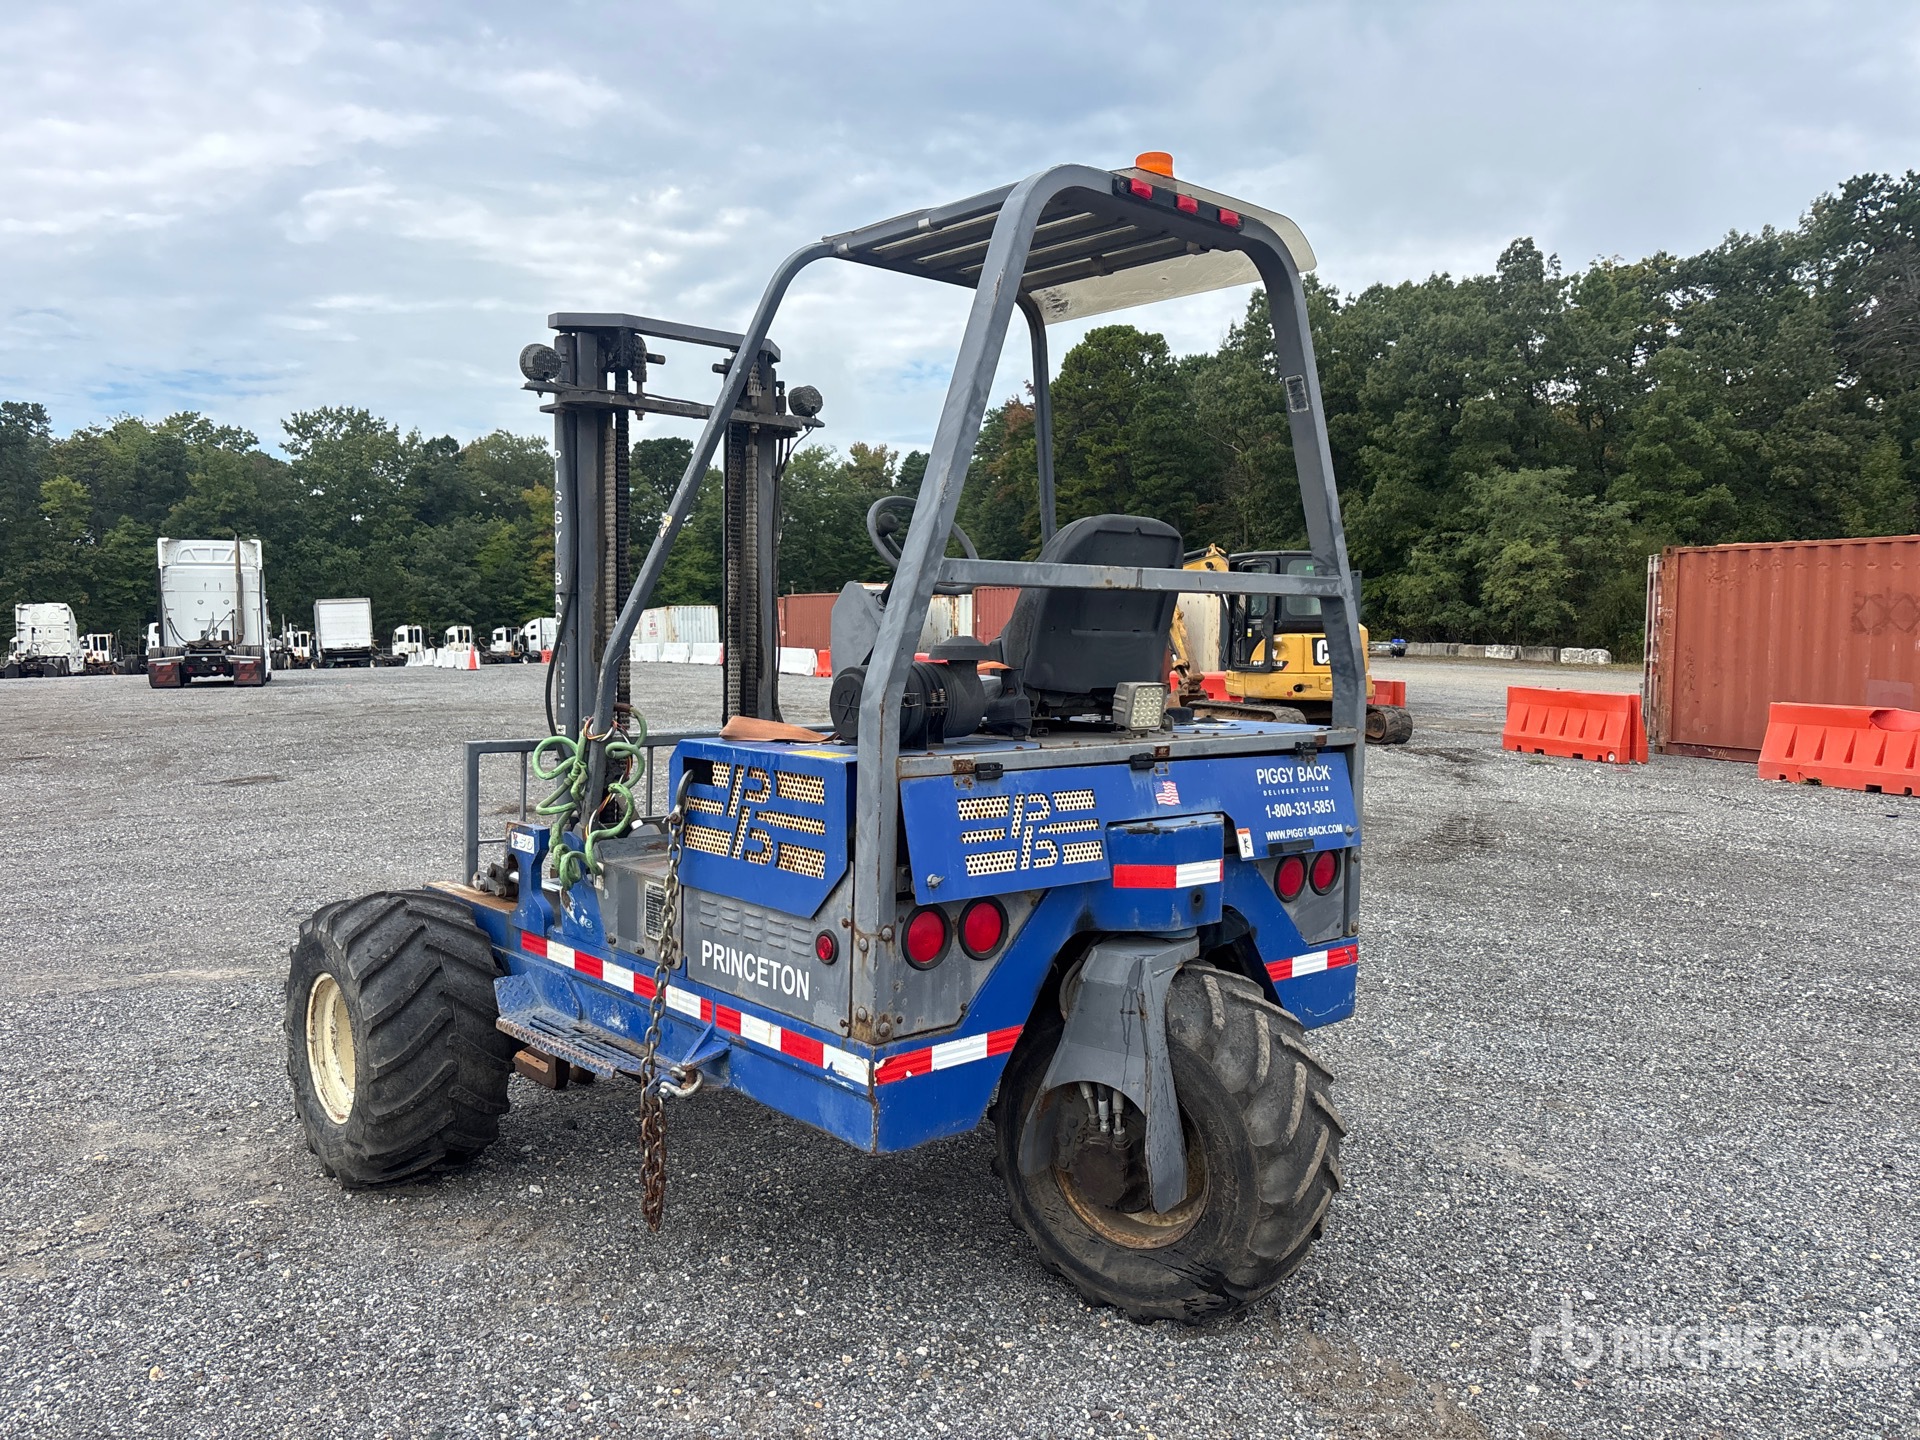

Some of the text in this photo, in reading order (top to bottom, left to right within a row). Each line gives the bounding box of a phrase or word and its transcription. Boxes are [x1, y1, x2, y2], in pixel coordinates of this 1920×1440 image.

[555, 450, 563, 626] PIGGY BAC
[1256, 765, 1331, 785] PIGGY BACK
[1263, 785, 1330, 797] DELIVERY SYSTEM
[1265, 799, 1336, 819] 1-800-331-5851
[1265, 824, 1344, 841] WWW.PIGGY-BACK.COM
[701, 939, 810, 1001] PRINCETON
